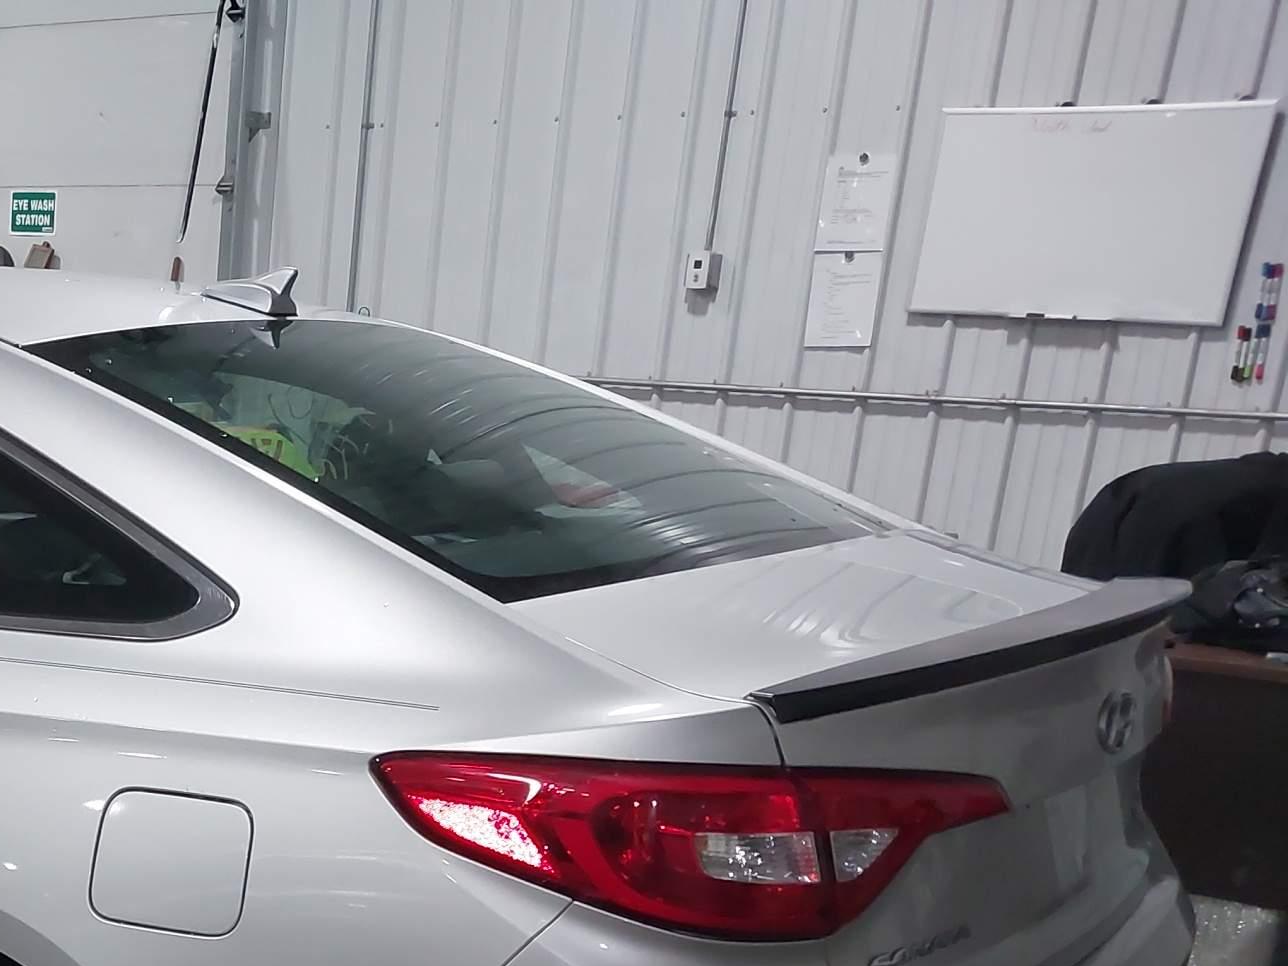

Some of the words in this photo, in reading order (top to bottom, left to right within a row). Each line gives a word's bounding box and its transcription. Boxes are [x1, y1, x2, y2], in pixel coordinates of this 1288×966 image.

[13, 199, 29, 211] EYE
[30, 199, 55, 211] WASH
[15, 213, 51, 226] STATION
